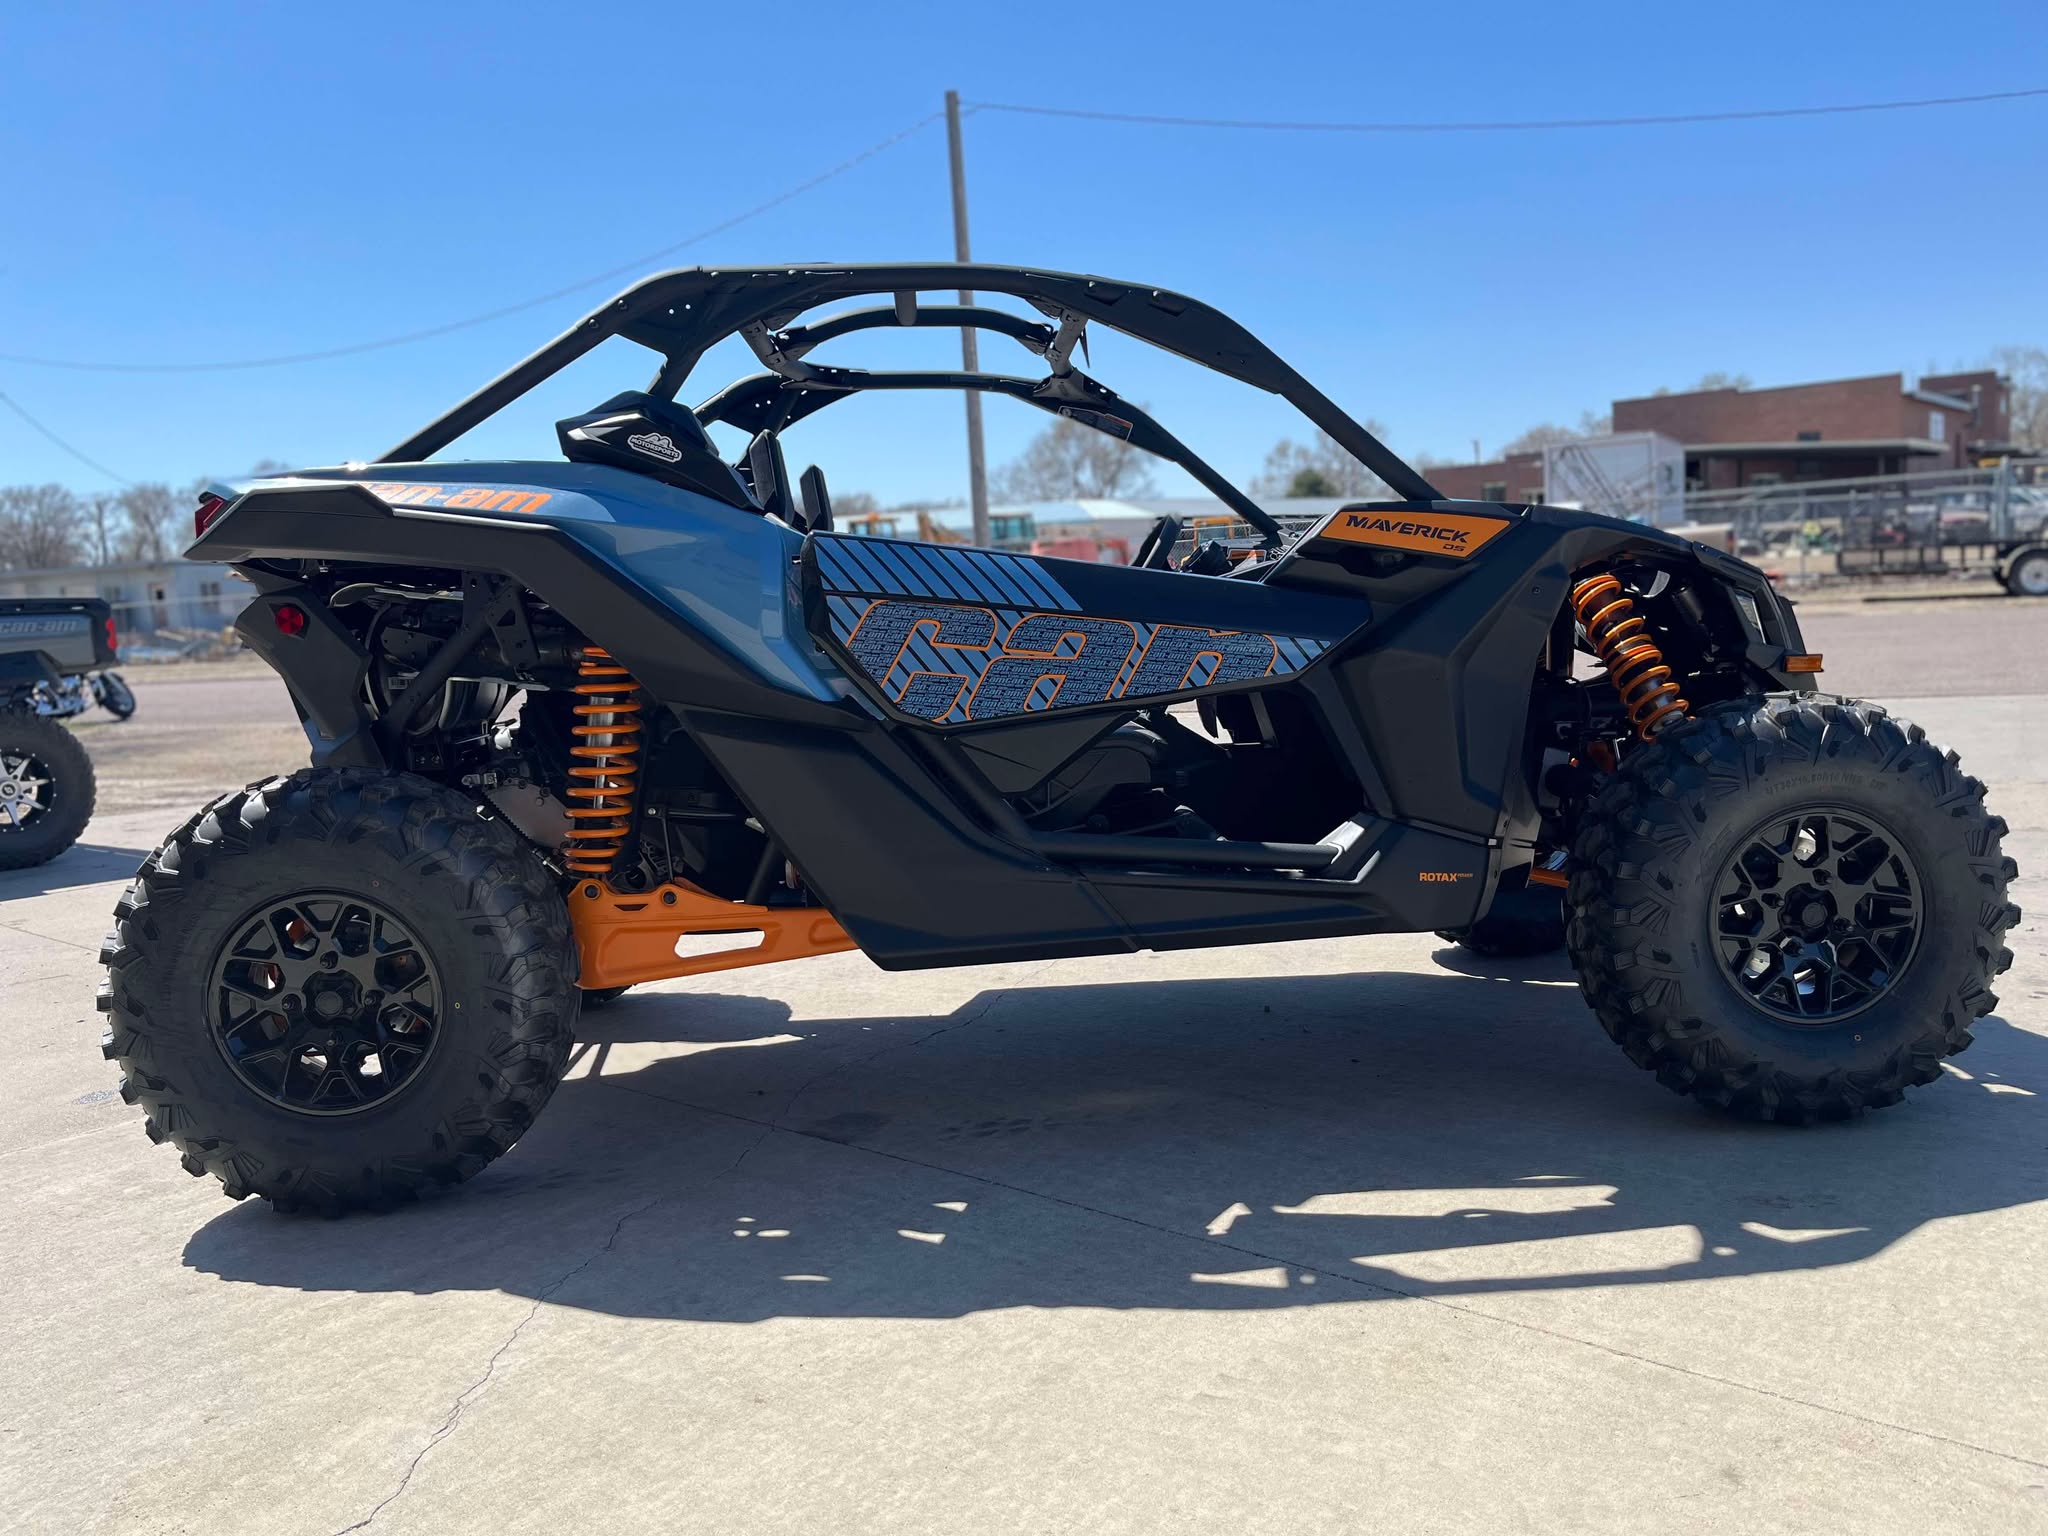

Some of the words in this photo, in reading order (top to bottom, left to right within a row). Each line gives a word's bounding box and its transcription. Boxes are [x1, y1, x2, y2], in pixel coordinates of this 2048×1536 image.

[630, 438, 679, 458] MOTORSPORTS
[361, 482, 552, 513] an-am
[1345, 515, 1471, 543] MAVERICK
[1442, 543, 1467, 552] DS
[0, 620, 77, 633] can-am
[1419, 872, 1457, 882] ROTAX
